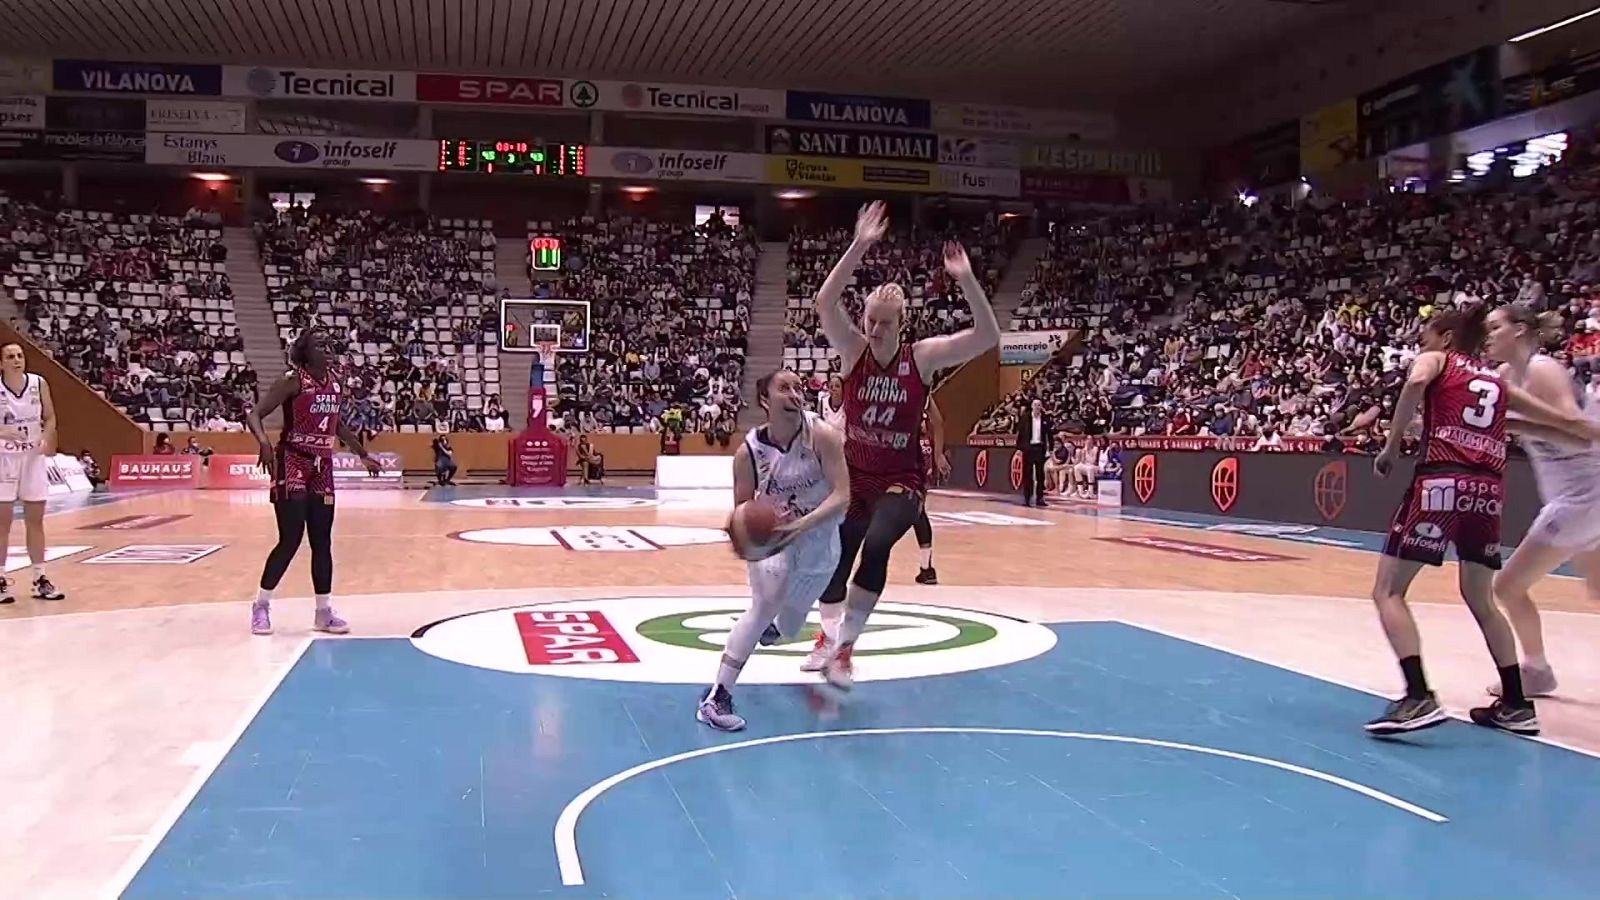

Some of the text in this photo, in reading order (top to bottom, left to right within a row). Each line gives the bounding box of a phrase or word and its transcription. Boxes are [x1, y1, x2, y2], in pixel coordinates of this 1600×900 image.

[82, 69, 196, 92] VILANOVA
[280, 71, 394, 97] Tecnical
[459, 80, 561, 101] SPAR
[647, 88, 739, 111] Tecnical
[810, 102, 909, 126] VILANOVA
[164, 134, 217, 150] Estanys
[323, 141, 398, 159] infoself
[799, 130, 851, 154] SANT
[188, 151, 226, 164] Blaus
[658, 152, 728, 170] infoself
[315, 394, 337, 403] SPAR
[857, 386, 908, 403] GIRONA
[1462, 378, 1501, 429] 3
[318, 416, 330, 432] 4
[862, 405, 896, 427] 44
[120, 464, 192, 475] BAUHAUS
[530, 611, 620, 665] SPAR
